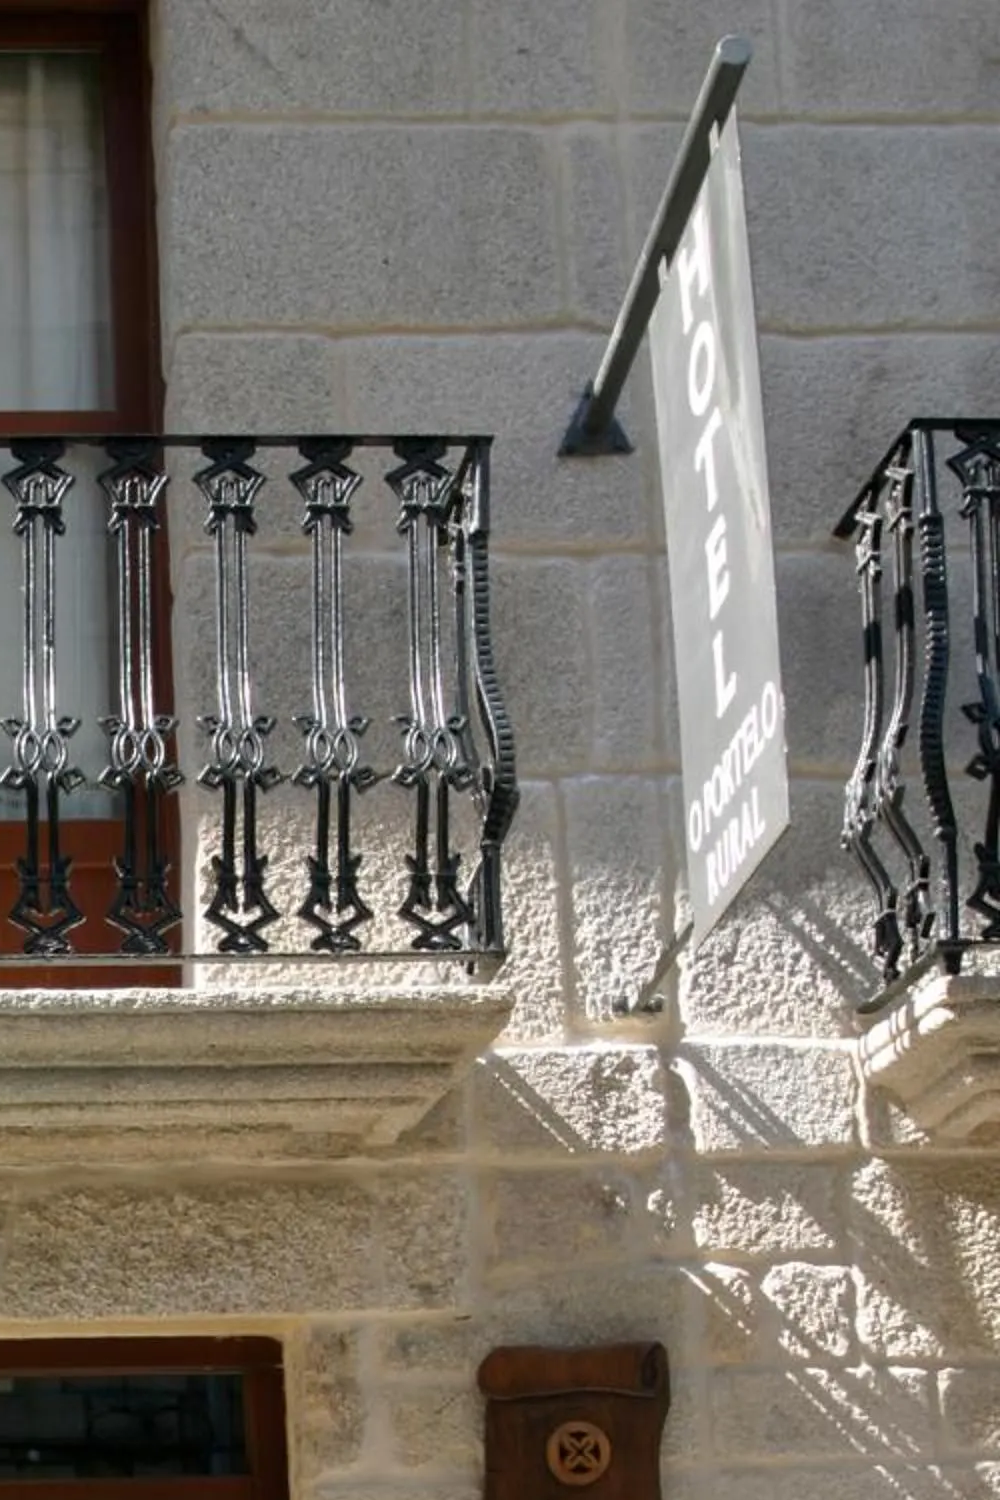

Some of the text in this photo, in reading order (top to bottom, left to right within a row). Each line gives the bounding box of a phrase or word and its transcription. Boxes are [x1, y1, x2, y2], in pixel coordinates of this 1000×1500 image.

[677, 206, 738, 719] HOTEL
[689, 681, 778, 852] O PORTELO
[705, 786, 766, 906] RURAL
